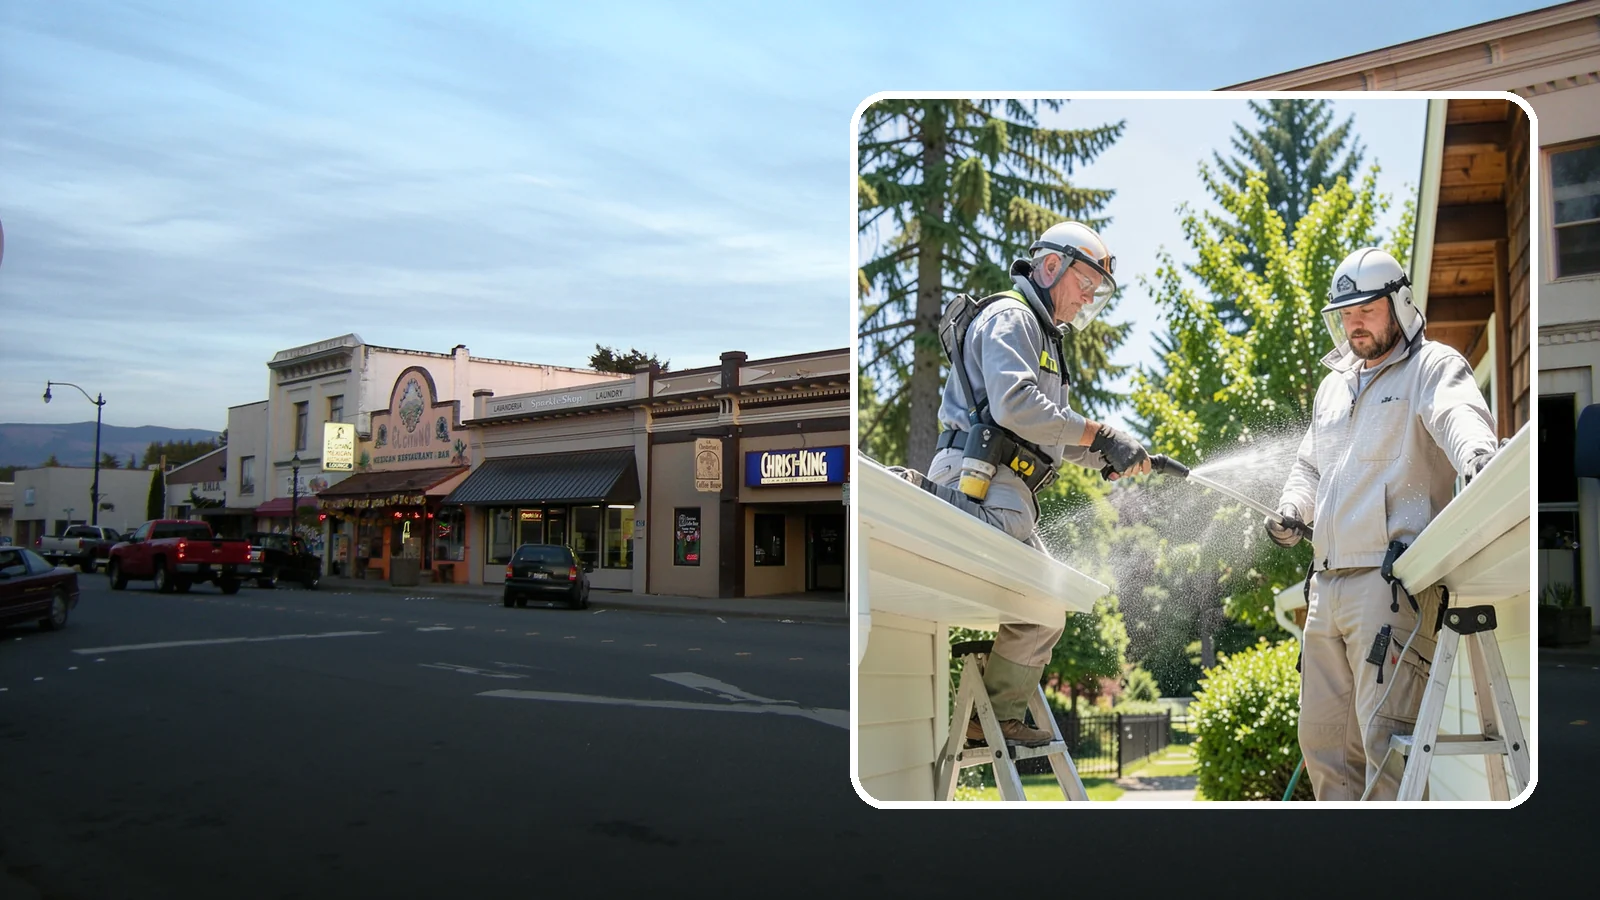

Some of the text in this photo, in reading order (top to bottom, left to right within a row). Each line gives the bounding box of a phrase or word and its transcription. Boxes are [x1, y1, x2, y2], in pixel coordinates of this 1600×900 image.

[562, 394, 583, 405] Shop
[595, 389, 623, 400] LAUNDRY
[374, 455, 396, 464] MEXICAN
[397, 452, 433, 462] RESTAURANT
[438, 450, 450, 459] BAR
